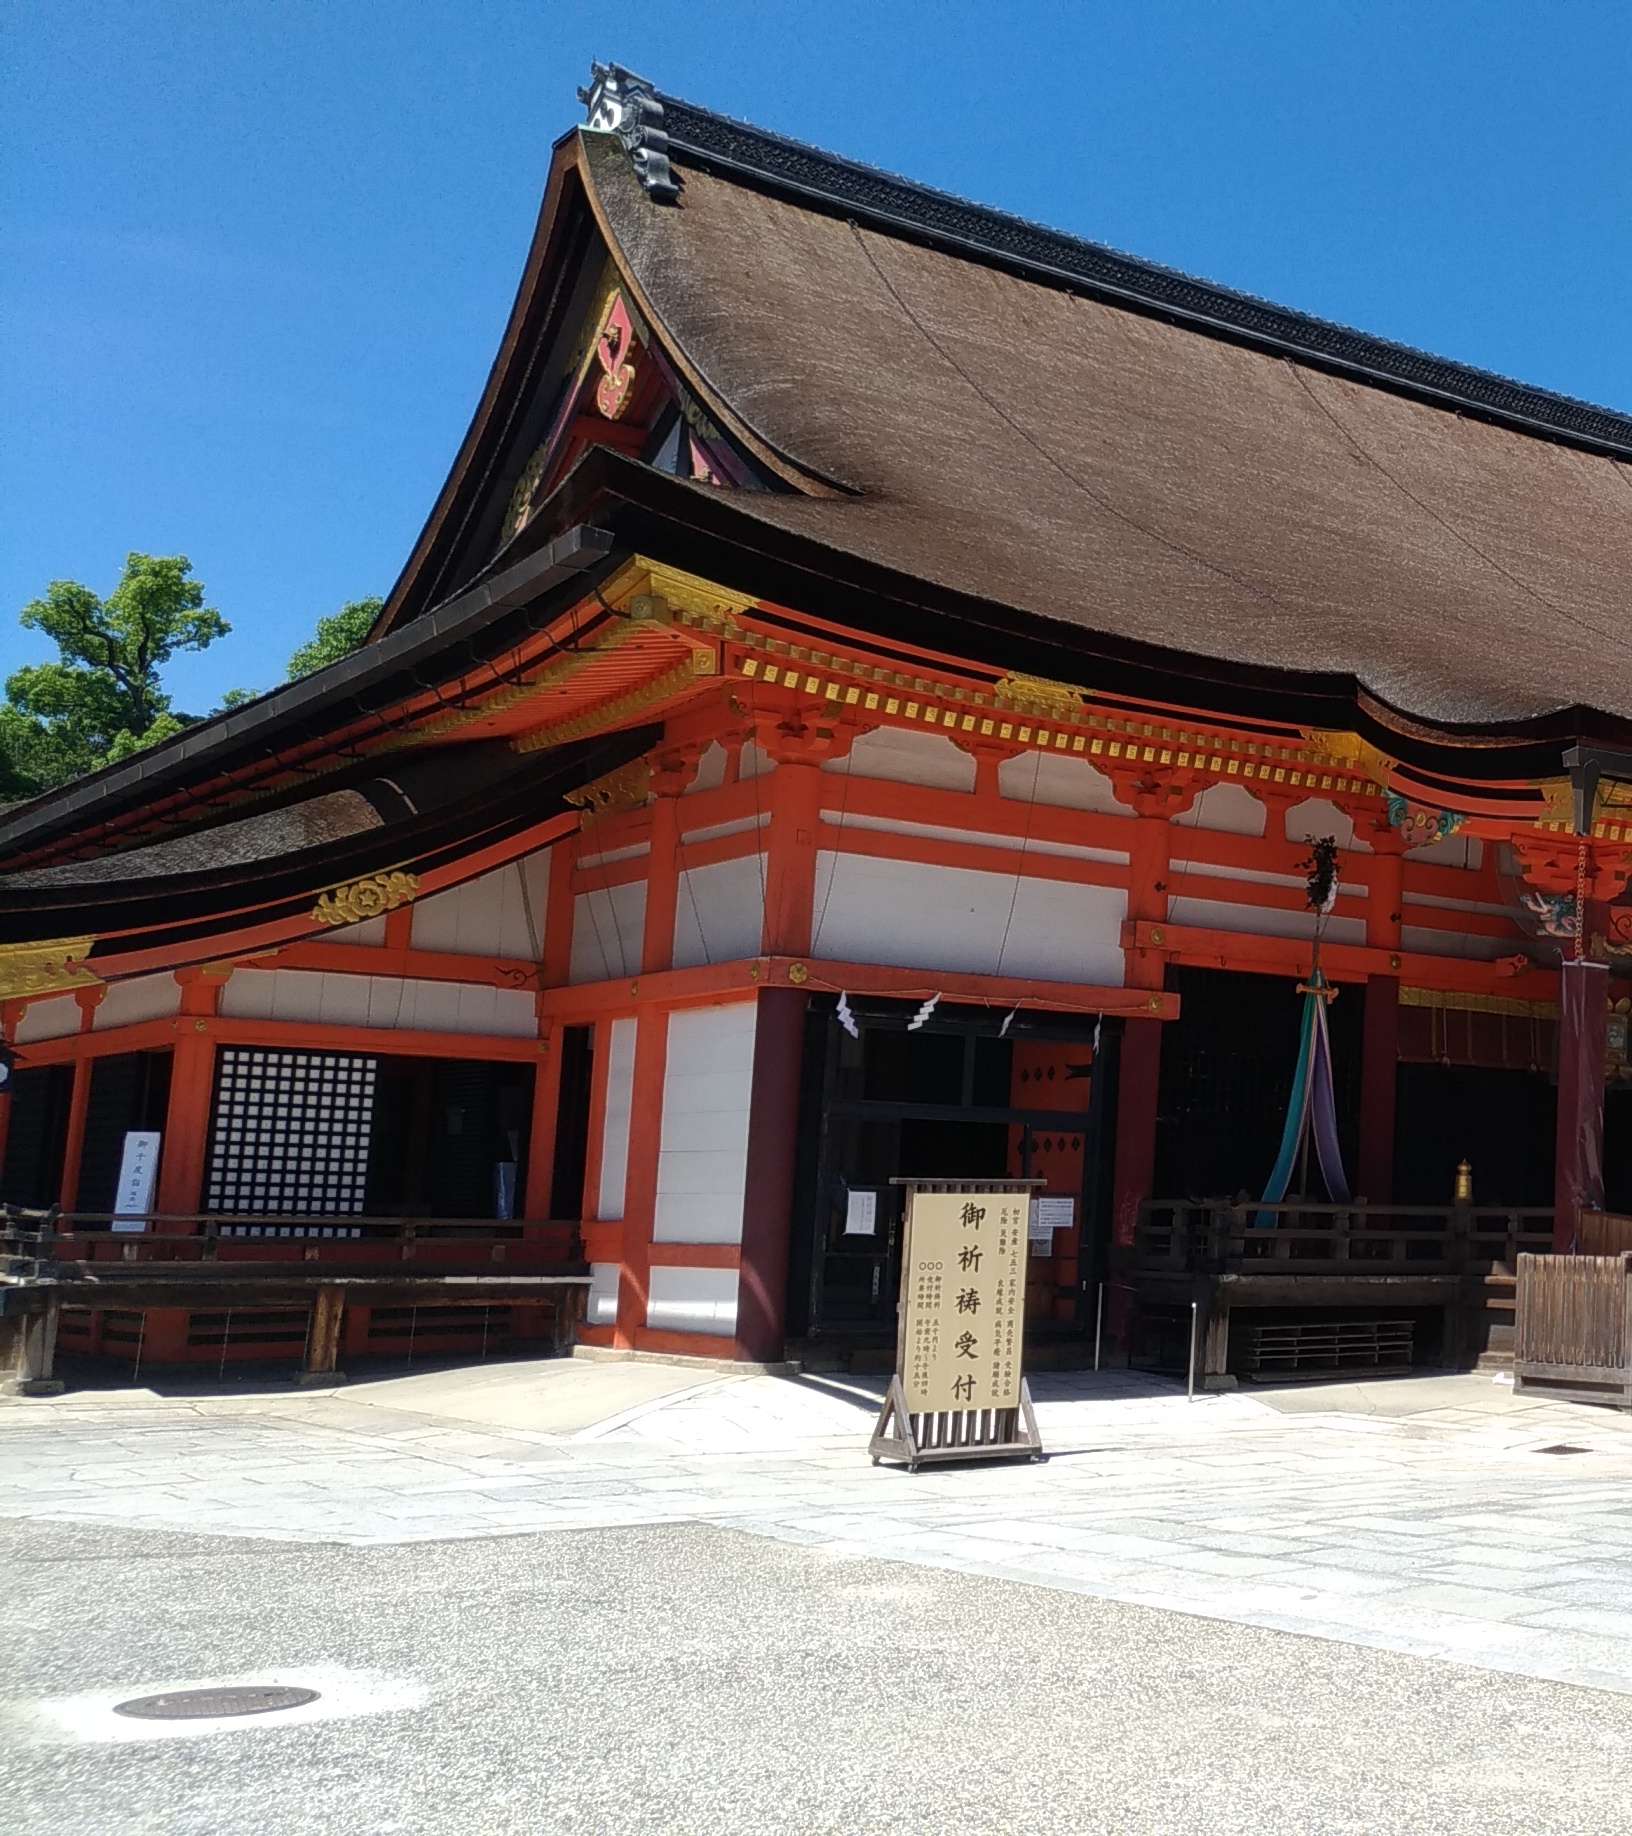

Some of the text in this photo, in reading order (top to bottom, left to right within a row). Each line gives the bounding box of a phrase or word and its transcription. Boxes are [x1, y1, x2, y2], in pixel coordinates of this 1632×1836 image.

[1009, 1249, 1018, 1275] 七五三
[951, 1202, 986, 1402] 御祈祷受付
[1007, 1279, 1016, 1314] 家内安全
